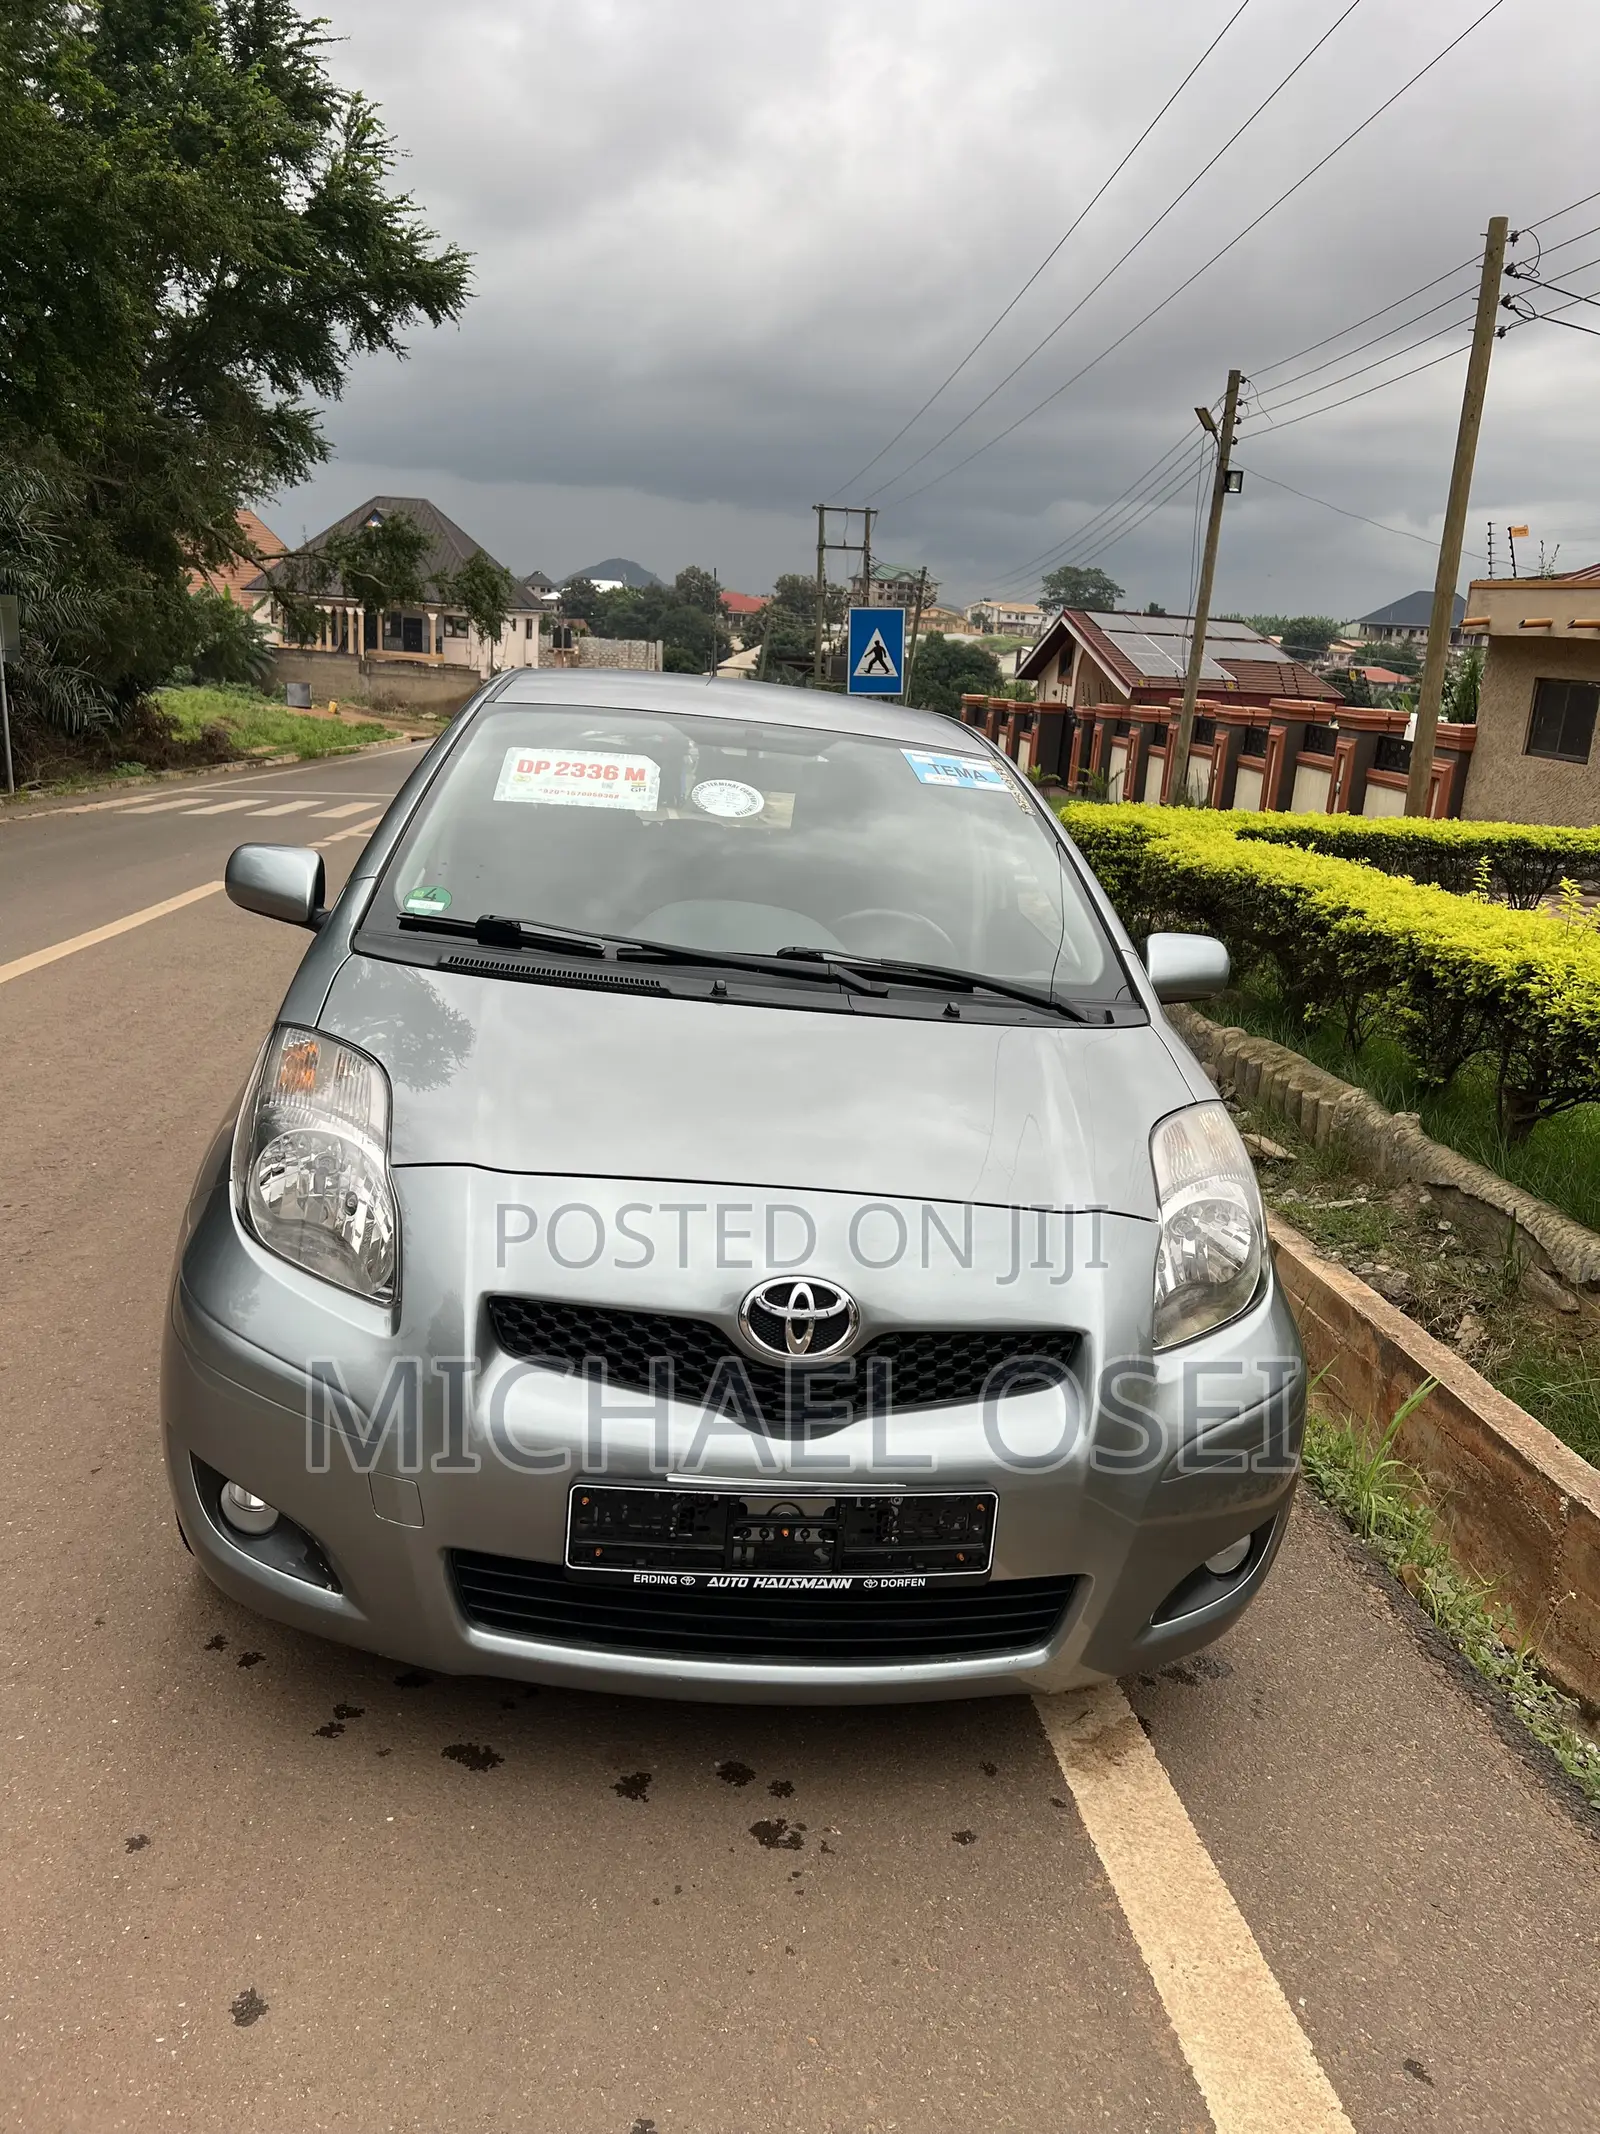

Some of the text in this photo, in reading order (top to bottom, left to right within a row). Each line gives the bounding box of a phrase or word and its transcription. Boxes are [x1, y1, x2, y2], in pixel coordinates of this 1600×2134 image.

[516, 759, 645, 781] DP 2336 M
[927, 763, 988, 781] TEMA
[706, 782, 740, 790] TERMINAL
[423, 887, 437, 901] 4
[633, 1574, 678, 1585] ERDING
[707, 1576, 853, 1590] AUTO HAUSMANN
[880, 1577, 926, 1588] DORFEN
